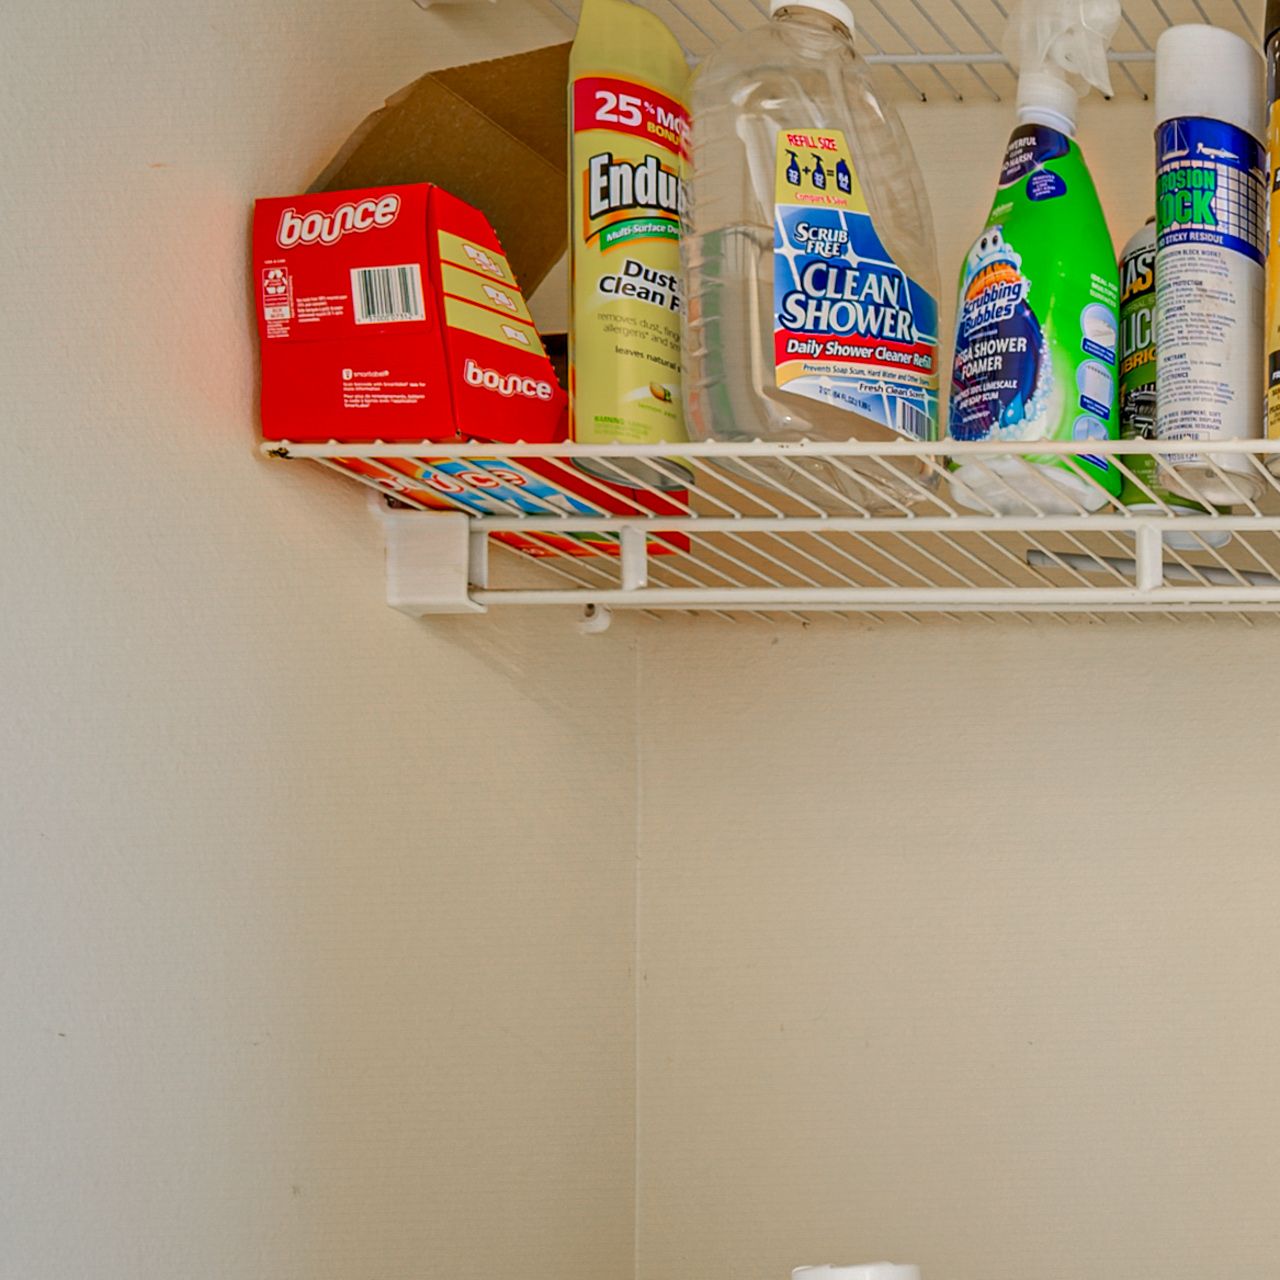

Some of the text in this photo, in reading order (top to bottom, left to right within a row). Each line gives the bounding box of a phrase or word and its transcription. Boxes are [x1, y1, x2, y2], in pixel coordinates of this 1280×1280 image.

[278, 195, 399, 247] bounce
[794, 222, 848, 244] SCRUB
[806, 241, 841, 258] FREE
[1165, 231, 1224, 245] STICKY RESIDUE
[599, 276, 665, 306] Clean
[623, 259, 677, 293] Dust
[802, 262, 900, 309] CLEAN
[963, 282, 1022, 317] Scrubbing
[780, 293, 911, 341] SHOWER
[964, 302, 1013, 333] Bubbles
[786, 339, 932, 369] Daily Shower Cleaner Refill
[974, 337, 1028, 357] SHOWER
[465, 360, 552, 400] bounce
[962, 356, 1003, 379] FOAMER
[859, 383, 926, 399] Fresh Clean Scent
